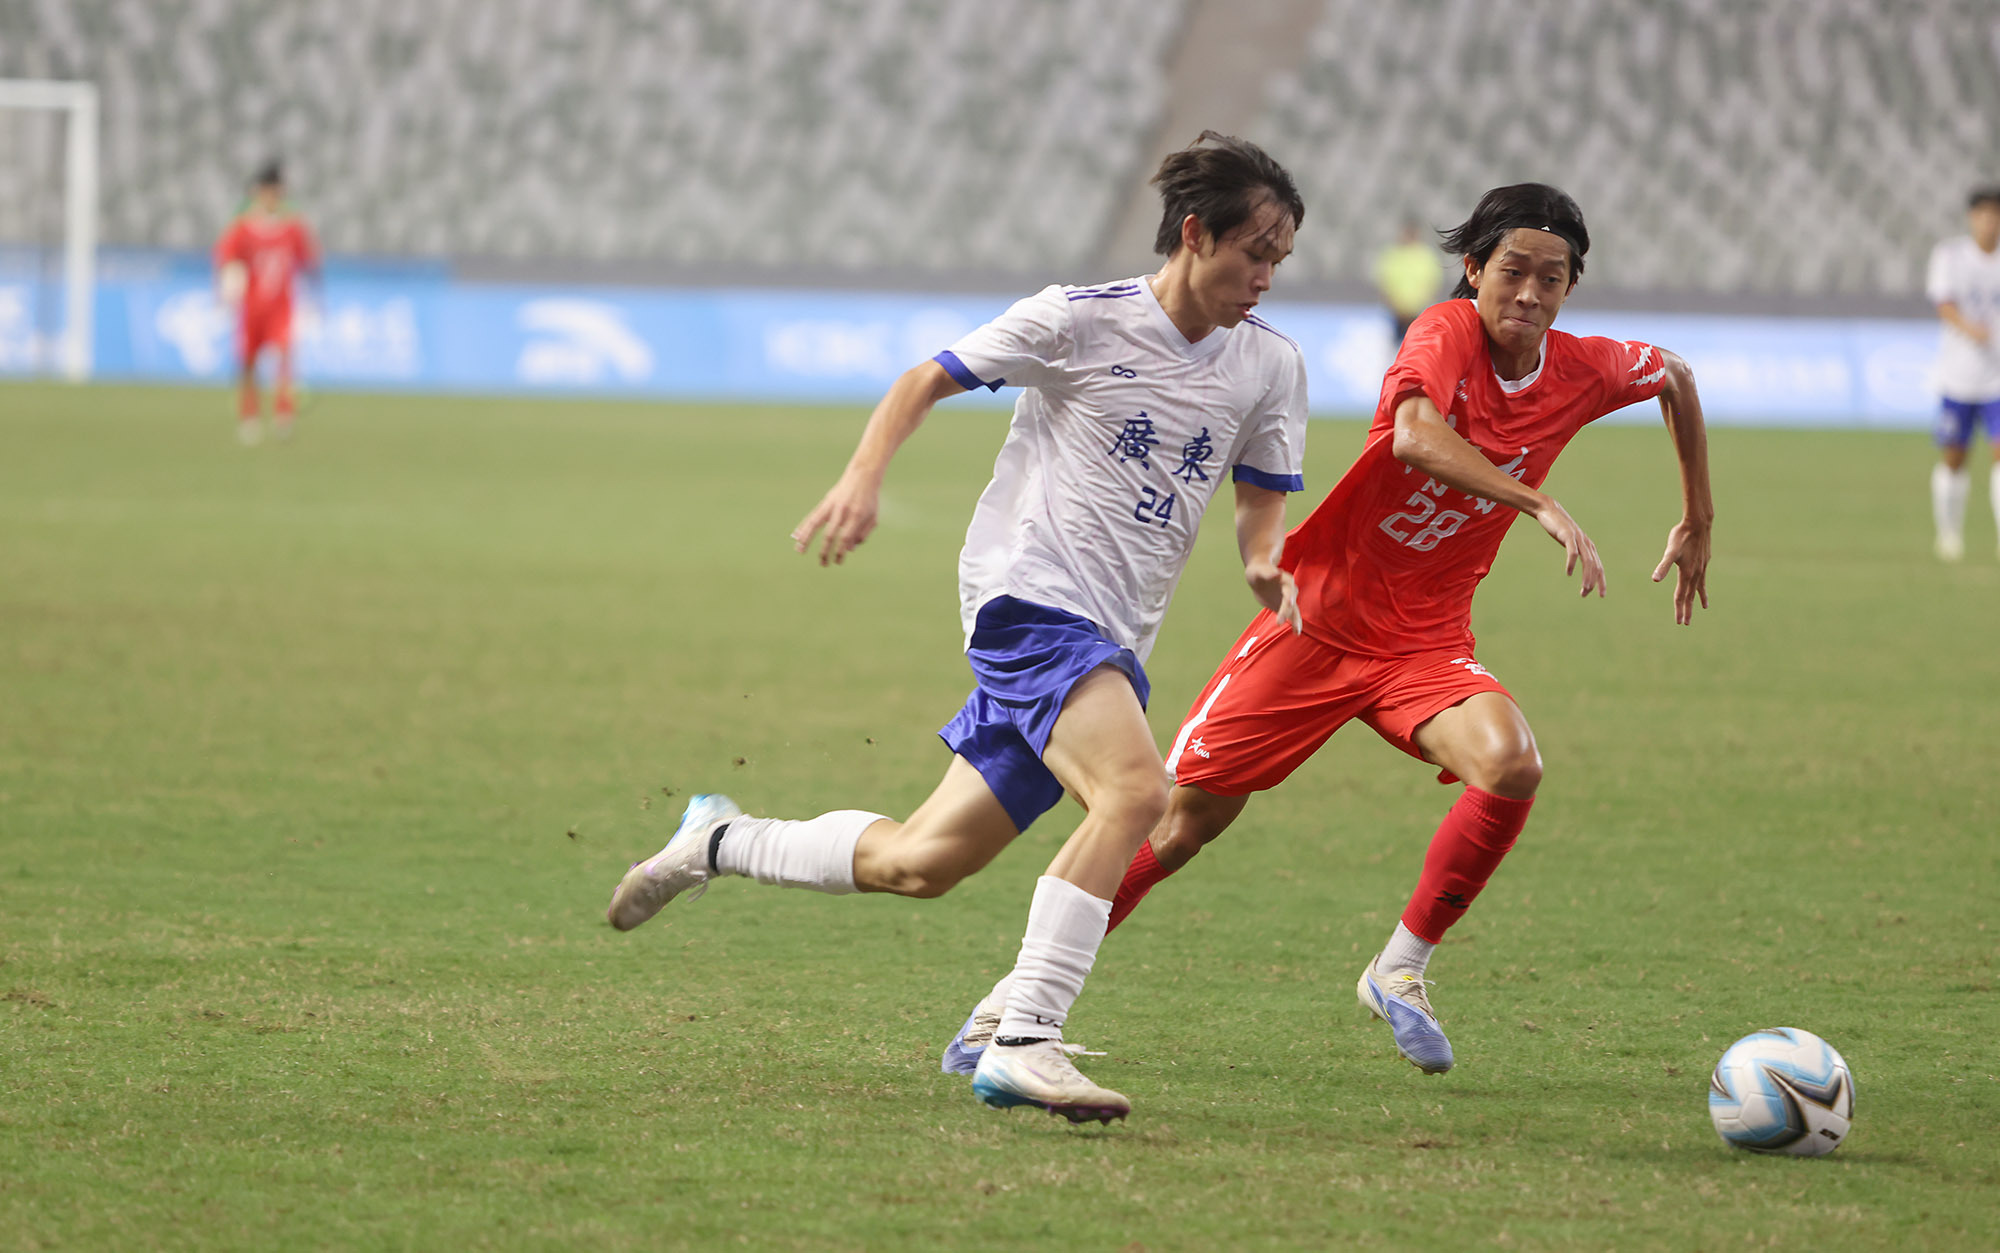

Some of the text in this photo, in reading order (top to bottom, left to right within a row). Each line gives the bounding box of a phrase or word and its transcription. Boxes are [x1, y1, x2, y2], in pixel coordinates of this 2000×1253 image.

[1108, 411, 1213, 484] 廣東
[1134, 486, 1175, 528] 24
[1378, 491, 1470, 552] 28
